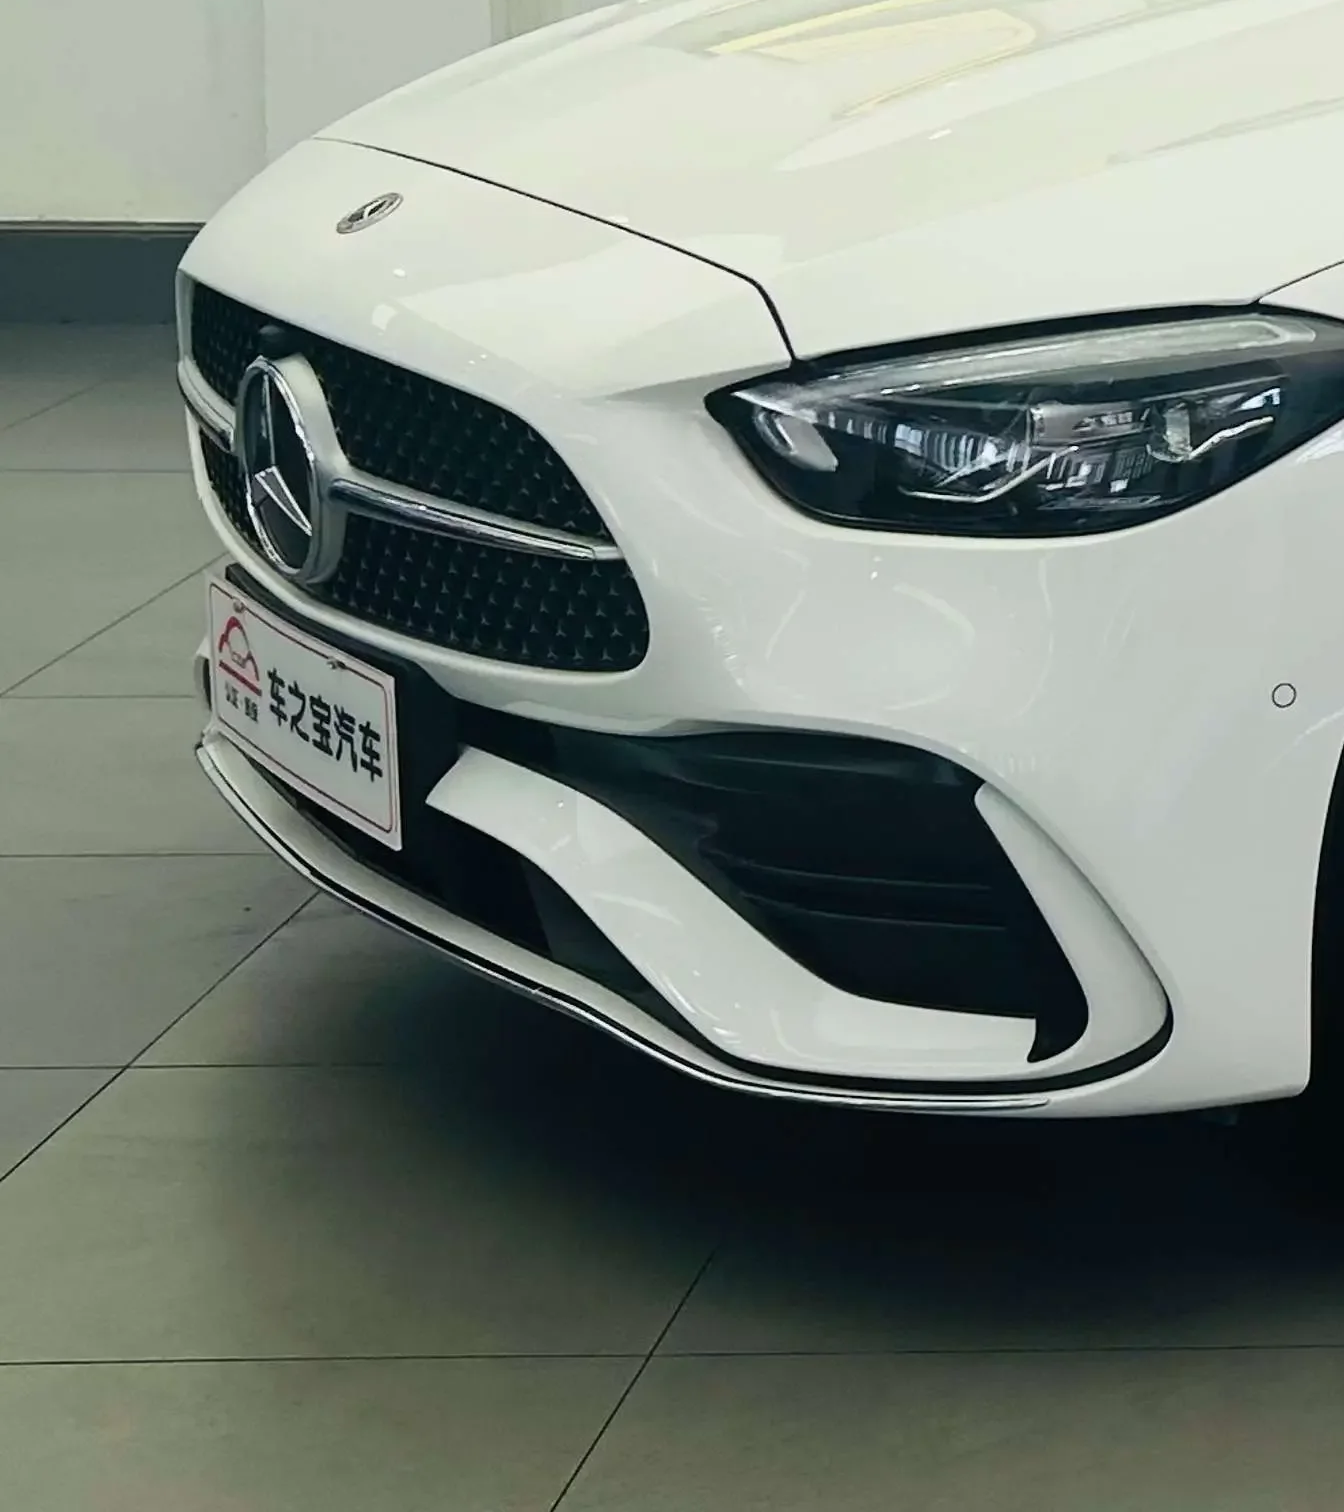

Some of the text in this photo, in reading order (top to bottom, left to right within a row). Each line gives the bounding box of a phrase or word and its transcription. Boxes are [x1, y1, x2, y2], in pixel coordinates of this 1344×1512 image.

[266, 667, 383, 783] 车之宝汽车
